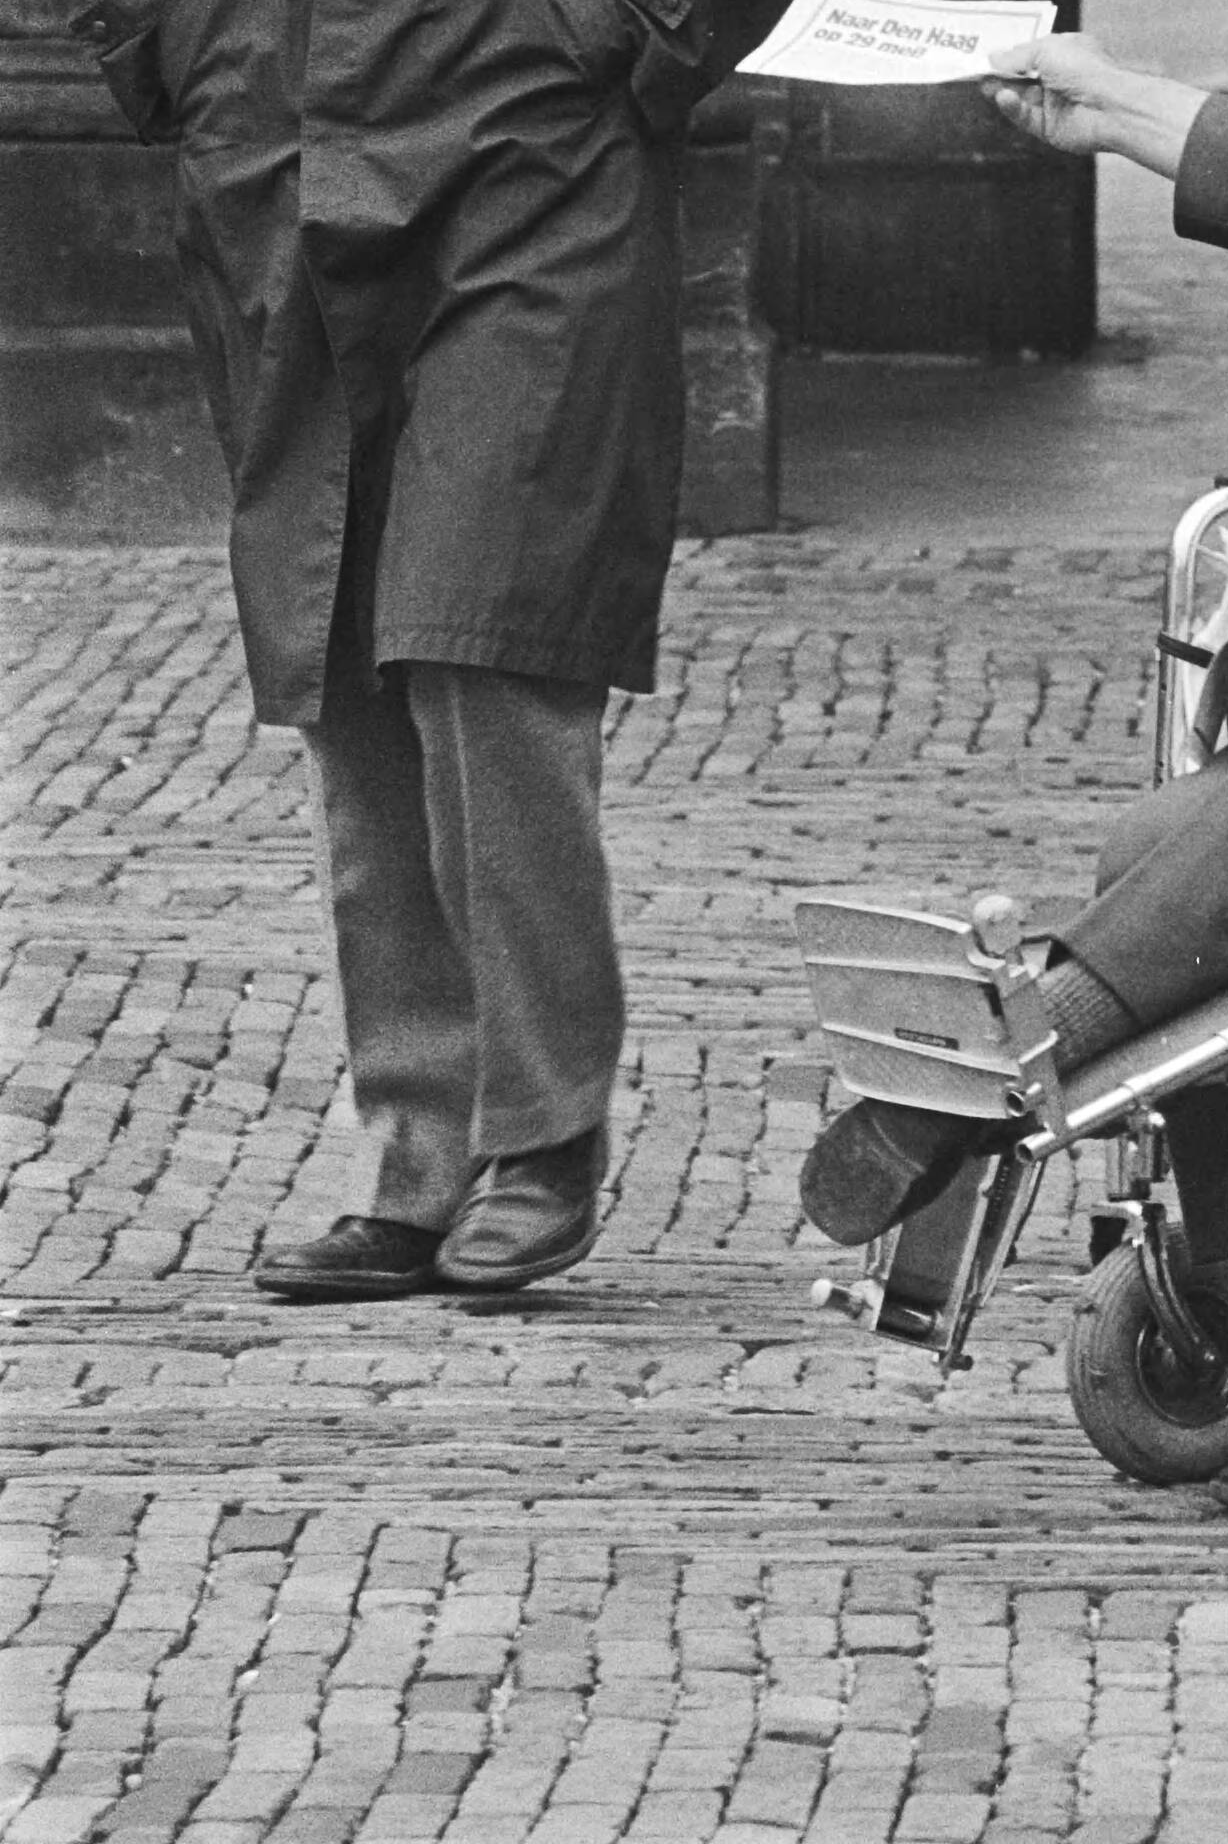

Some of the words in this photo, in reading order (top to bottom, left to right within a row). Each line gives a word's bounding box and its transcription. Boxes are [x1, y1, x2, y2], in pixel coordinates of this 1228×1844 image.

[813, 28, 843, 42] op
[826, 9, 879, 31] Naar
[881, 19, 922, 40] Den
[926, 27, 979, 54] Haag
